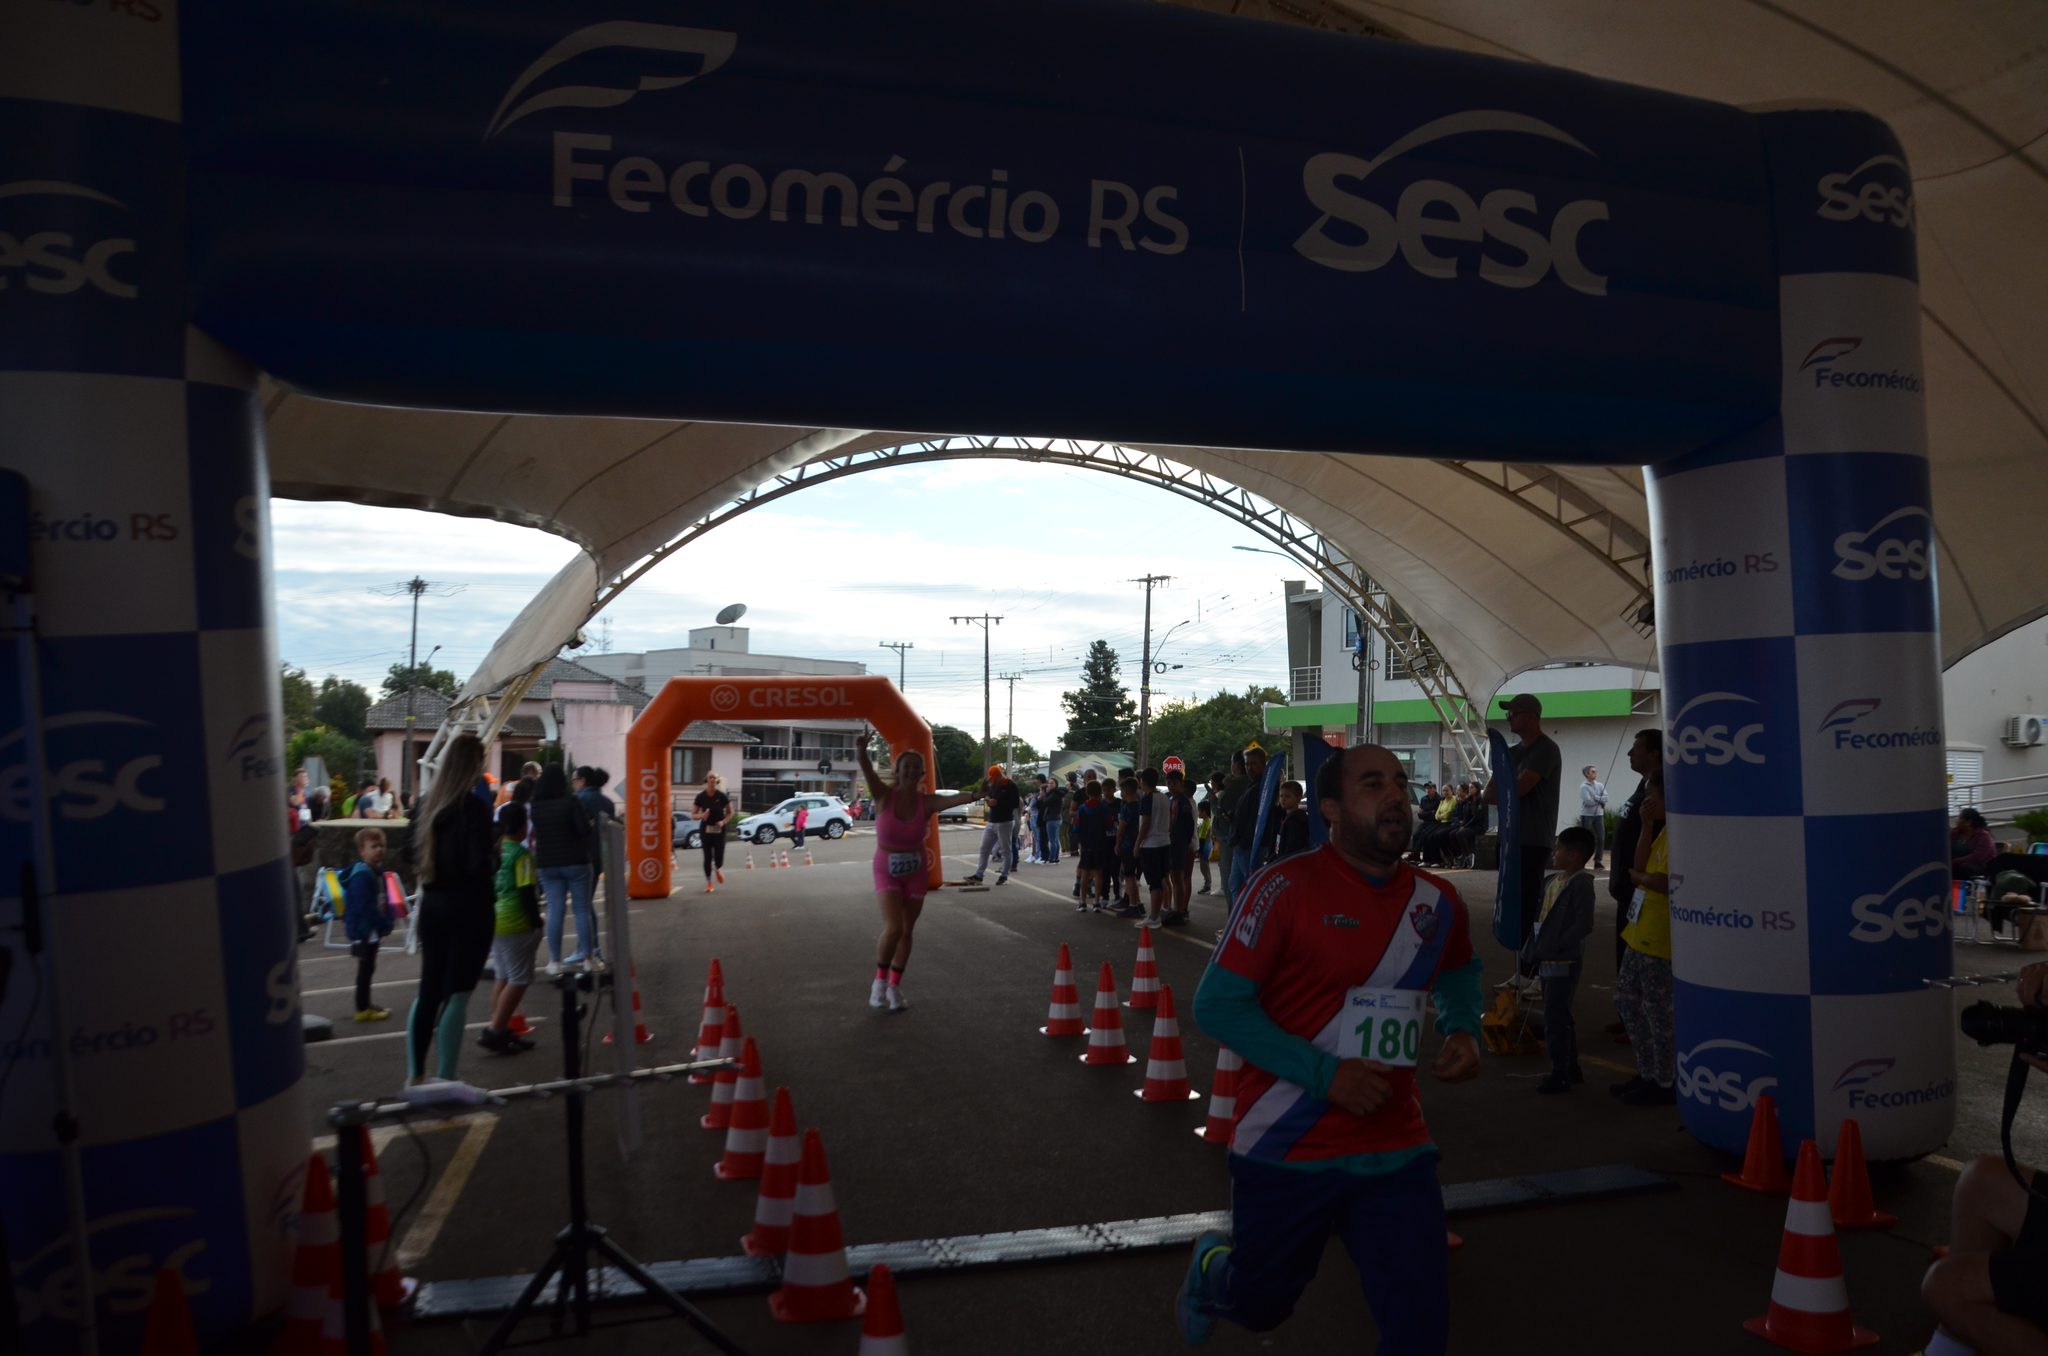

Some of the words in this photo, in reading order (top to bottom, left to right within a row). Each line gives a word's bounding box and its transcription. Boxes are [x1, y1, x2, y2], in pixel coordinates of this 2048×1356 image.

[552, 131, 1061, 243] Fecomércio
[1087, 179, 1190, 255] RS
[1292, 151, 1611, 296] Sesc
[131, 513, 178, 541] RS
[1744, 552, 1779, 574] RS
[749, 687, 855, 708] CRESOL
[640, 761, 659, 851] CRESOL
[1761, 910, 1796, 930] RS
[169, 1008, 214, 1041] RS
[1354, 1016, 1420, 1060] 180
